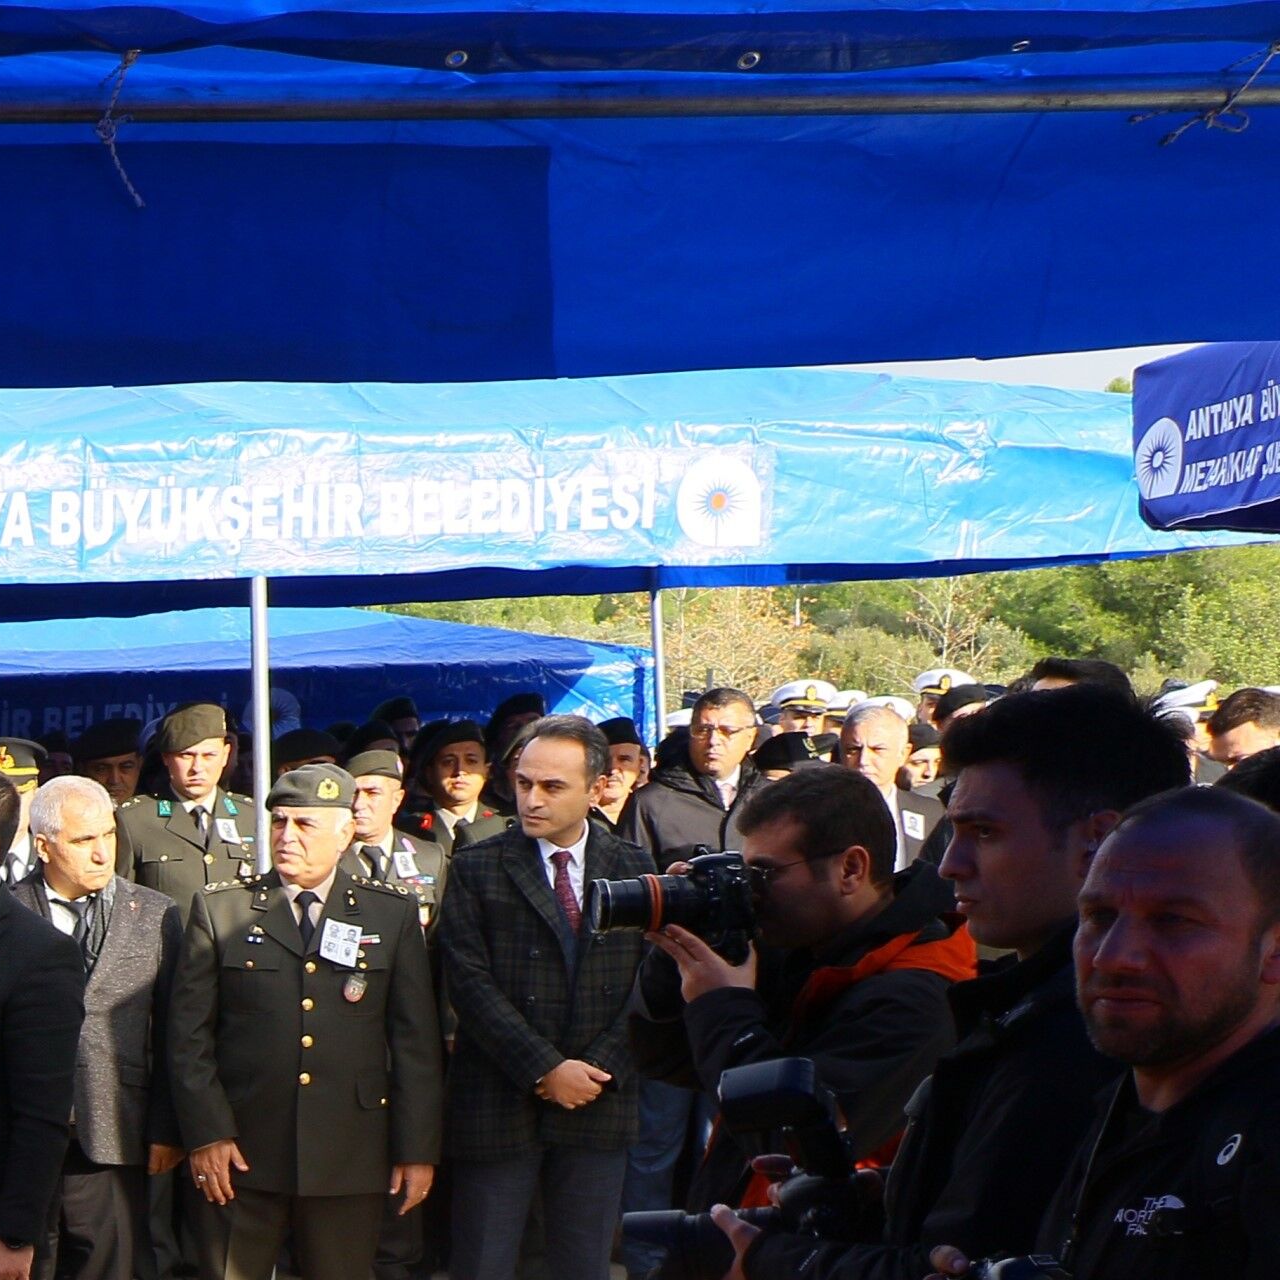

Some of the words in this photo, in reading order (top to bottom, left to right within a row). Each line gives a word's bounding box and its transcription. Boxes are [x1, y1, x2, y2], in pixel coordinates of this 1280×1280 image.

[1185, 393, 1254, 442] ANTALYA
[49, 467, 365, 556] BÜYÜKŞEHİR
[379, 458, 656, 535] BELEDİYESİ
[1114, 1208, 1156, 1223] NORT
